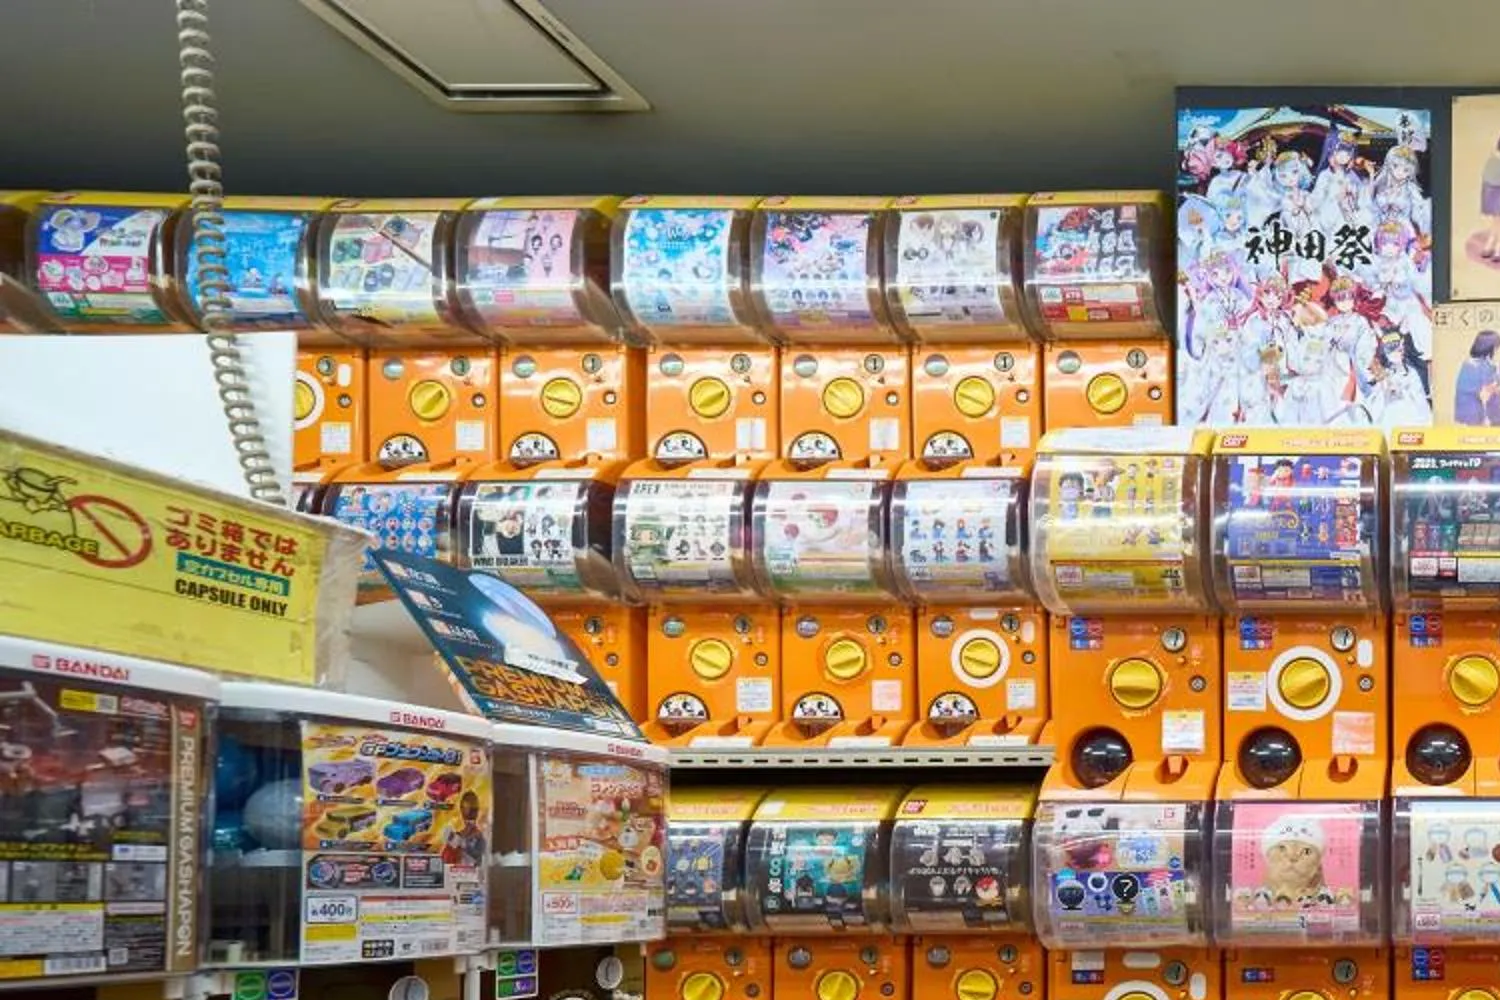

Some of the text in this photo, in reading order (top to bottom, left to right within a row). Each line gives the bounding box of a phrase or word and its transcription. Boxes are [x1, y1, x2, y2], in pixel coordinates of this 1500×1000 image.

[1244, 219, 1375, 272] 神田祭
[165, 505, 297, 556] ゴミ箱では
[165, 527, 295, 577] ありません
[175, 578, 289, 617] CAPSULE ONLY
[55, 657, 131, 681] BANDAI
[402, 712, 447, 729] BANDAI
[176, 736, 196, 957] PREMIUM GASHAPON
